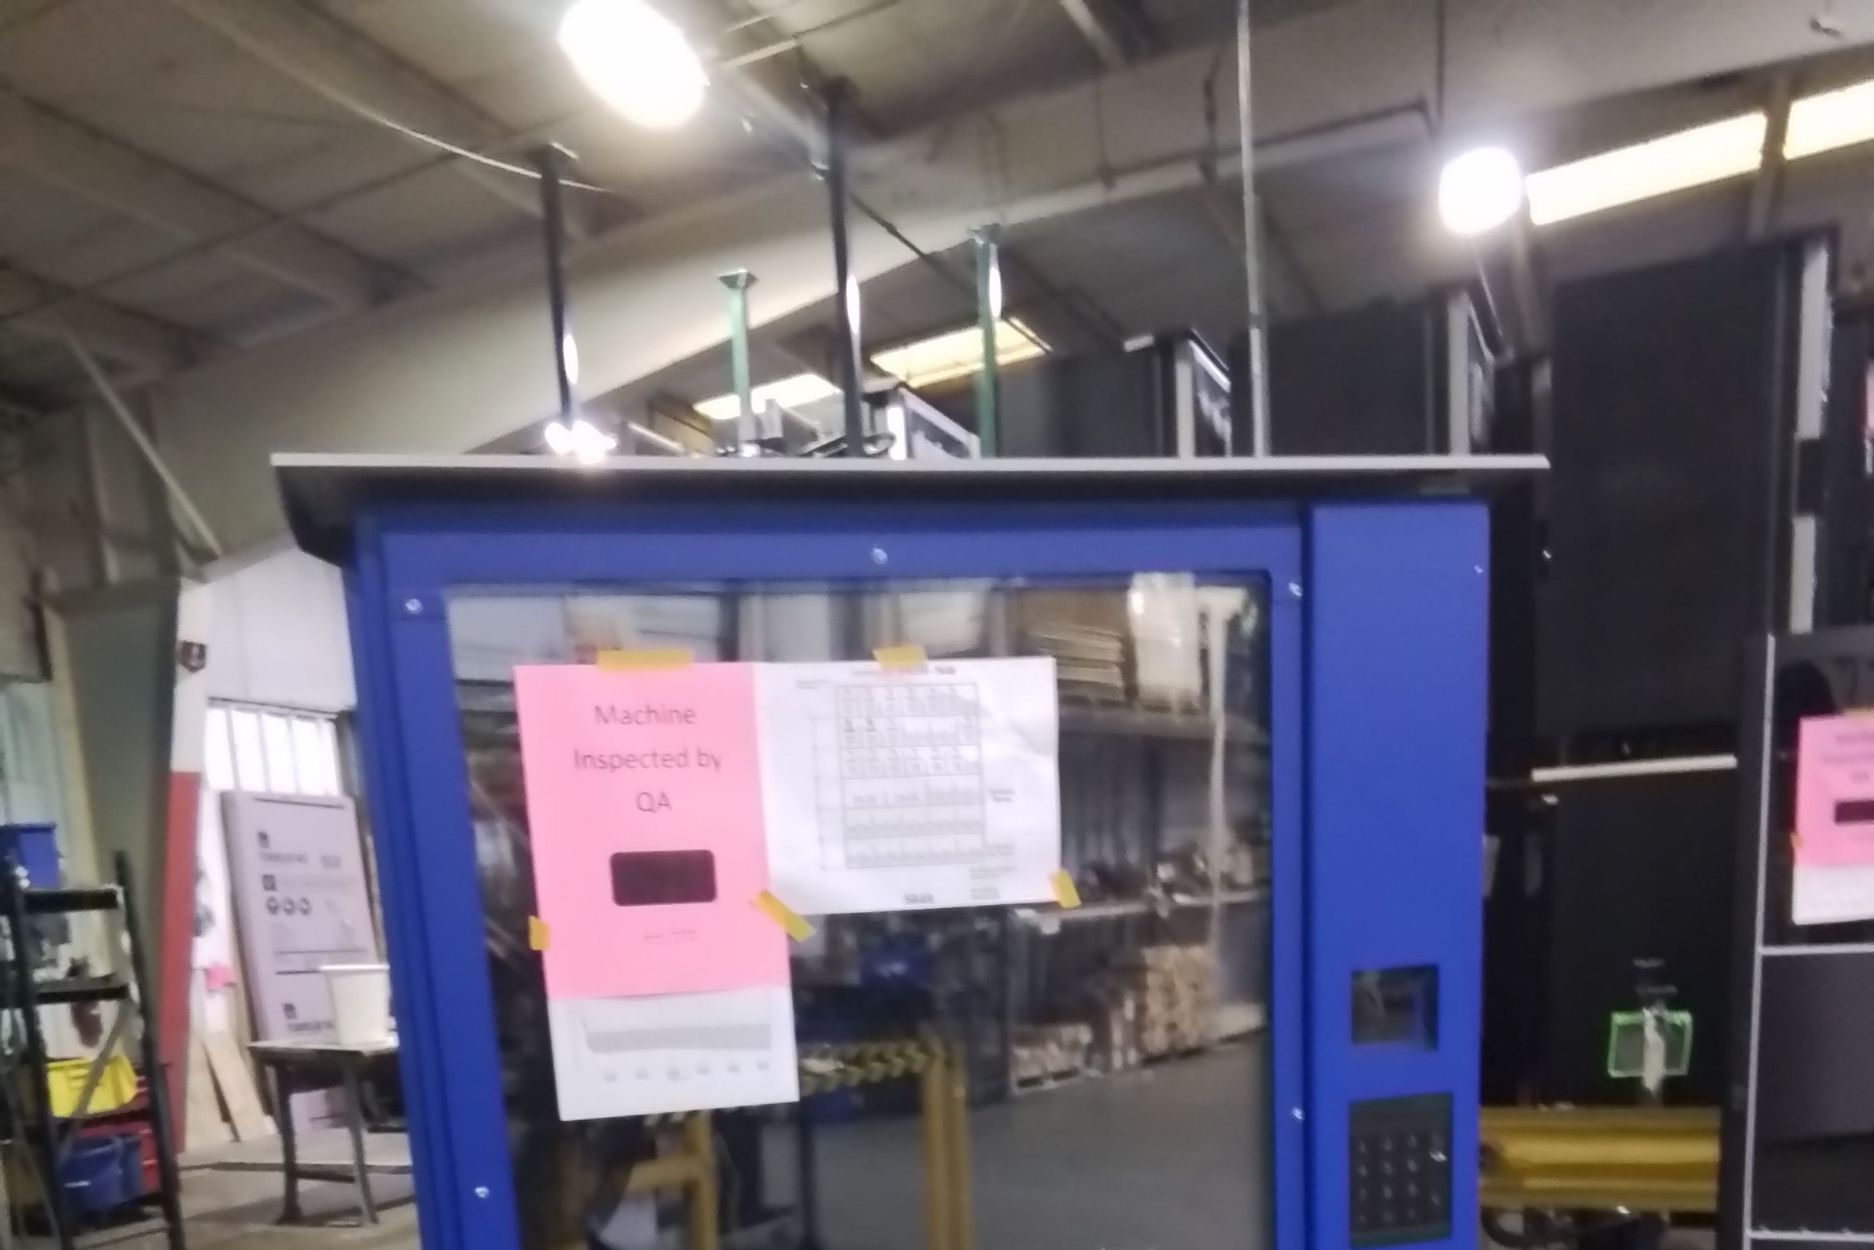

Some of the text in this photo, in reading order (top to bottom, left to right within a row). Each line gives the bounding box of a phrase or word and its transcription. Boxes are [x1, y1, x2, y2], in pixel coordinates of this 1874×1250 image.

[594, 704, 696, 725] Machine
[573, 746, 722, 773] Inspected by
[635, 791, 672, 814] QA
